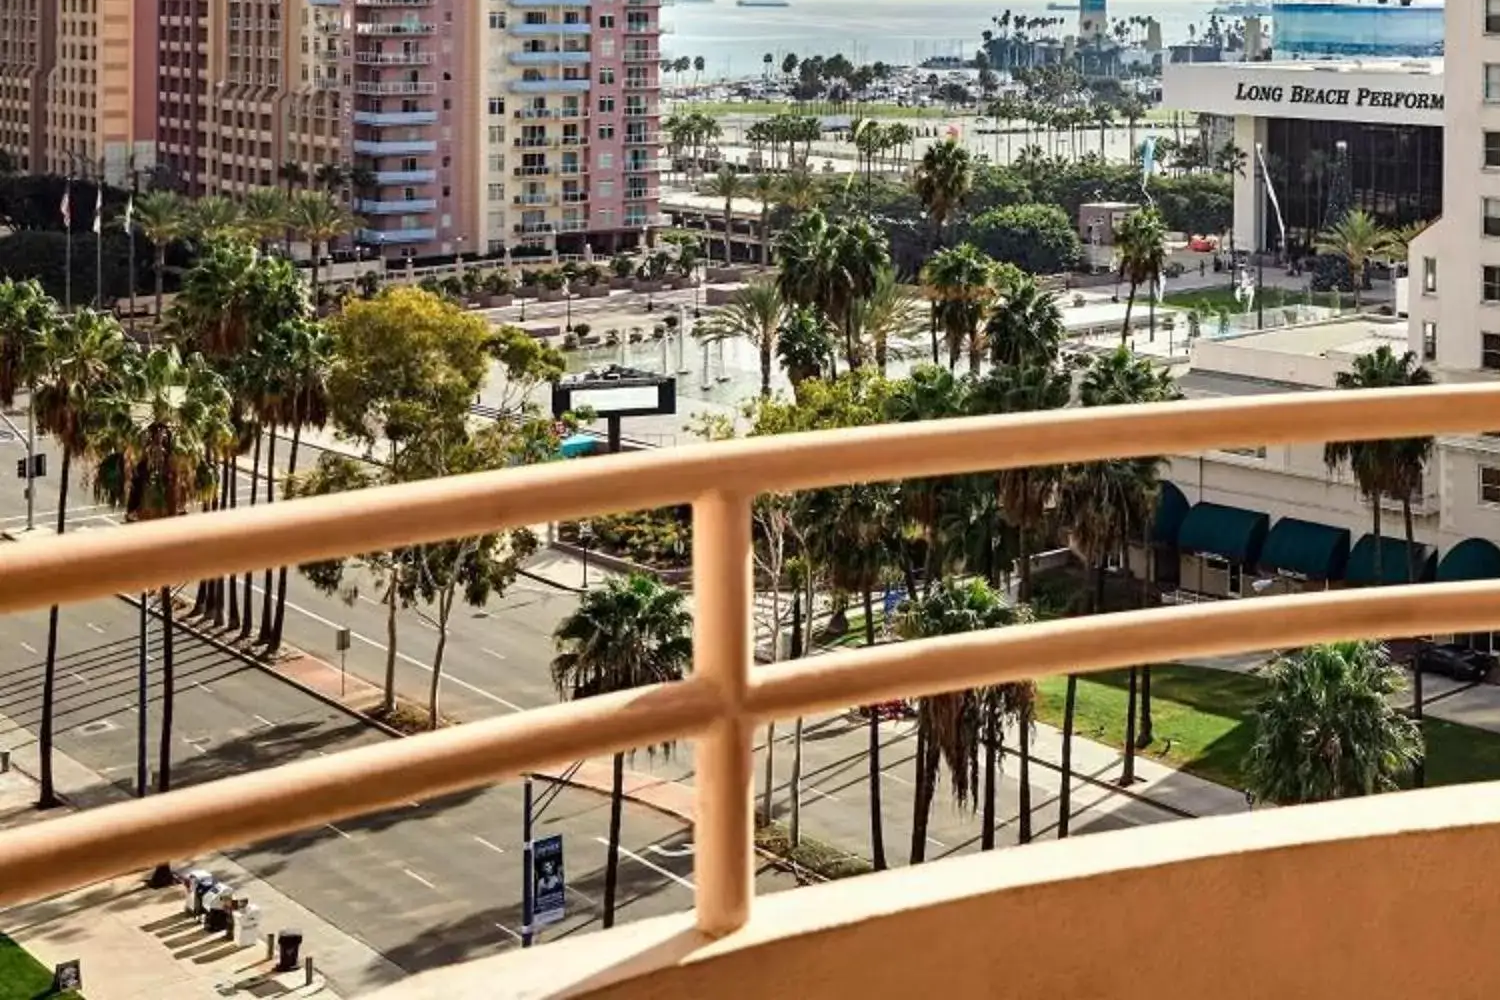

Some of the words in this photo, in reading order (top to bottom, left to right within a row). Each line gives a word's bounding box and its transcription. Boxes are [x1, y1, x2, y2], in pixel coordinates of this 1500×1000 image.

[1236, 83, 1283, 103] LONG
[1290, 86, 1349, 105] BEACH
[1357, 87, 1444, 110] PERFORM
